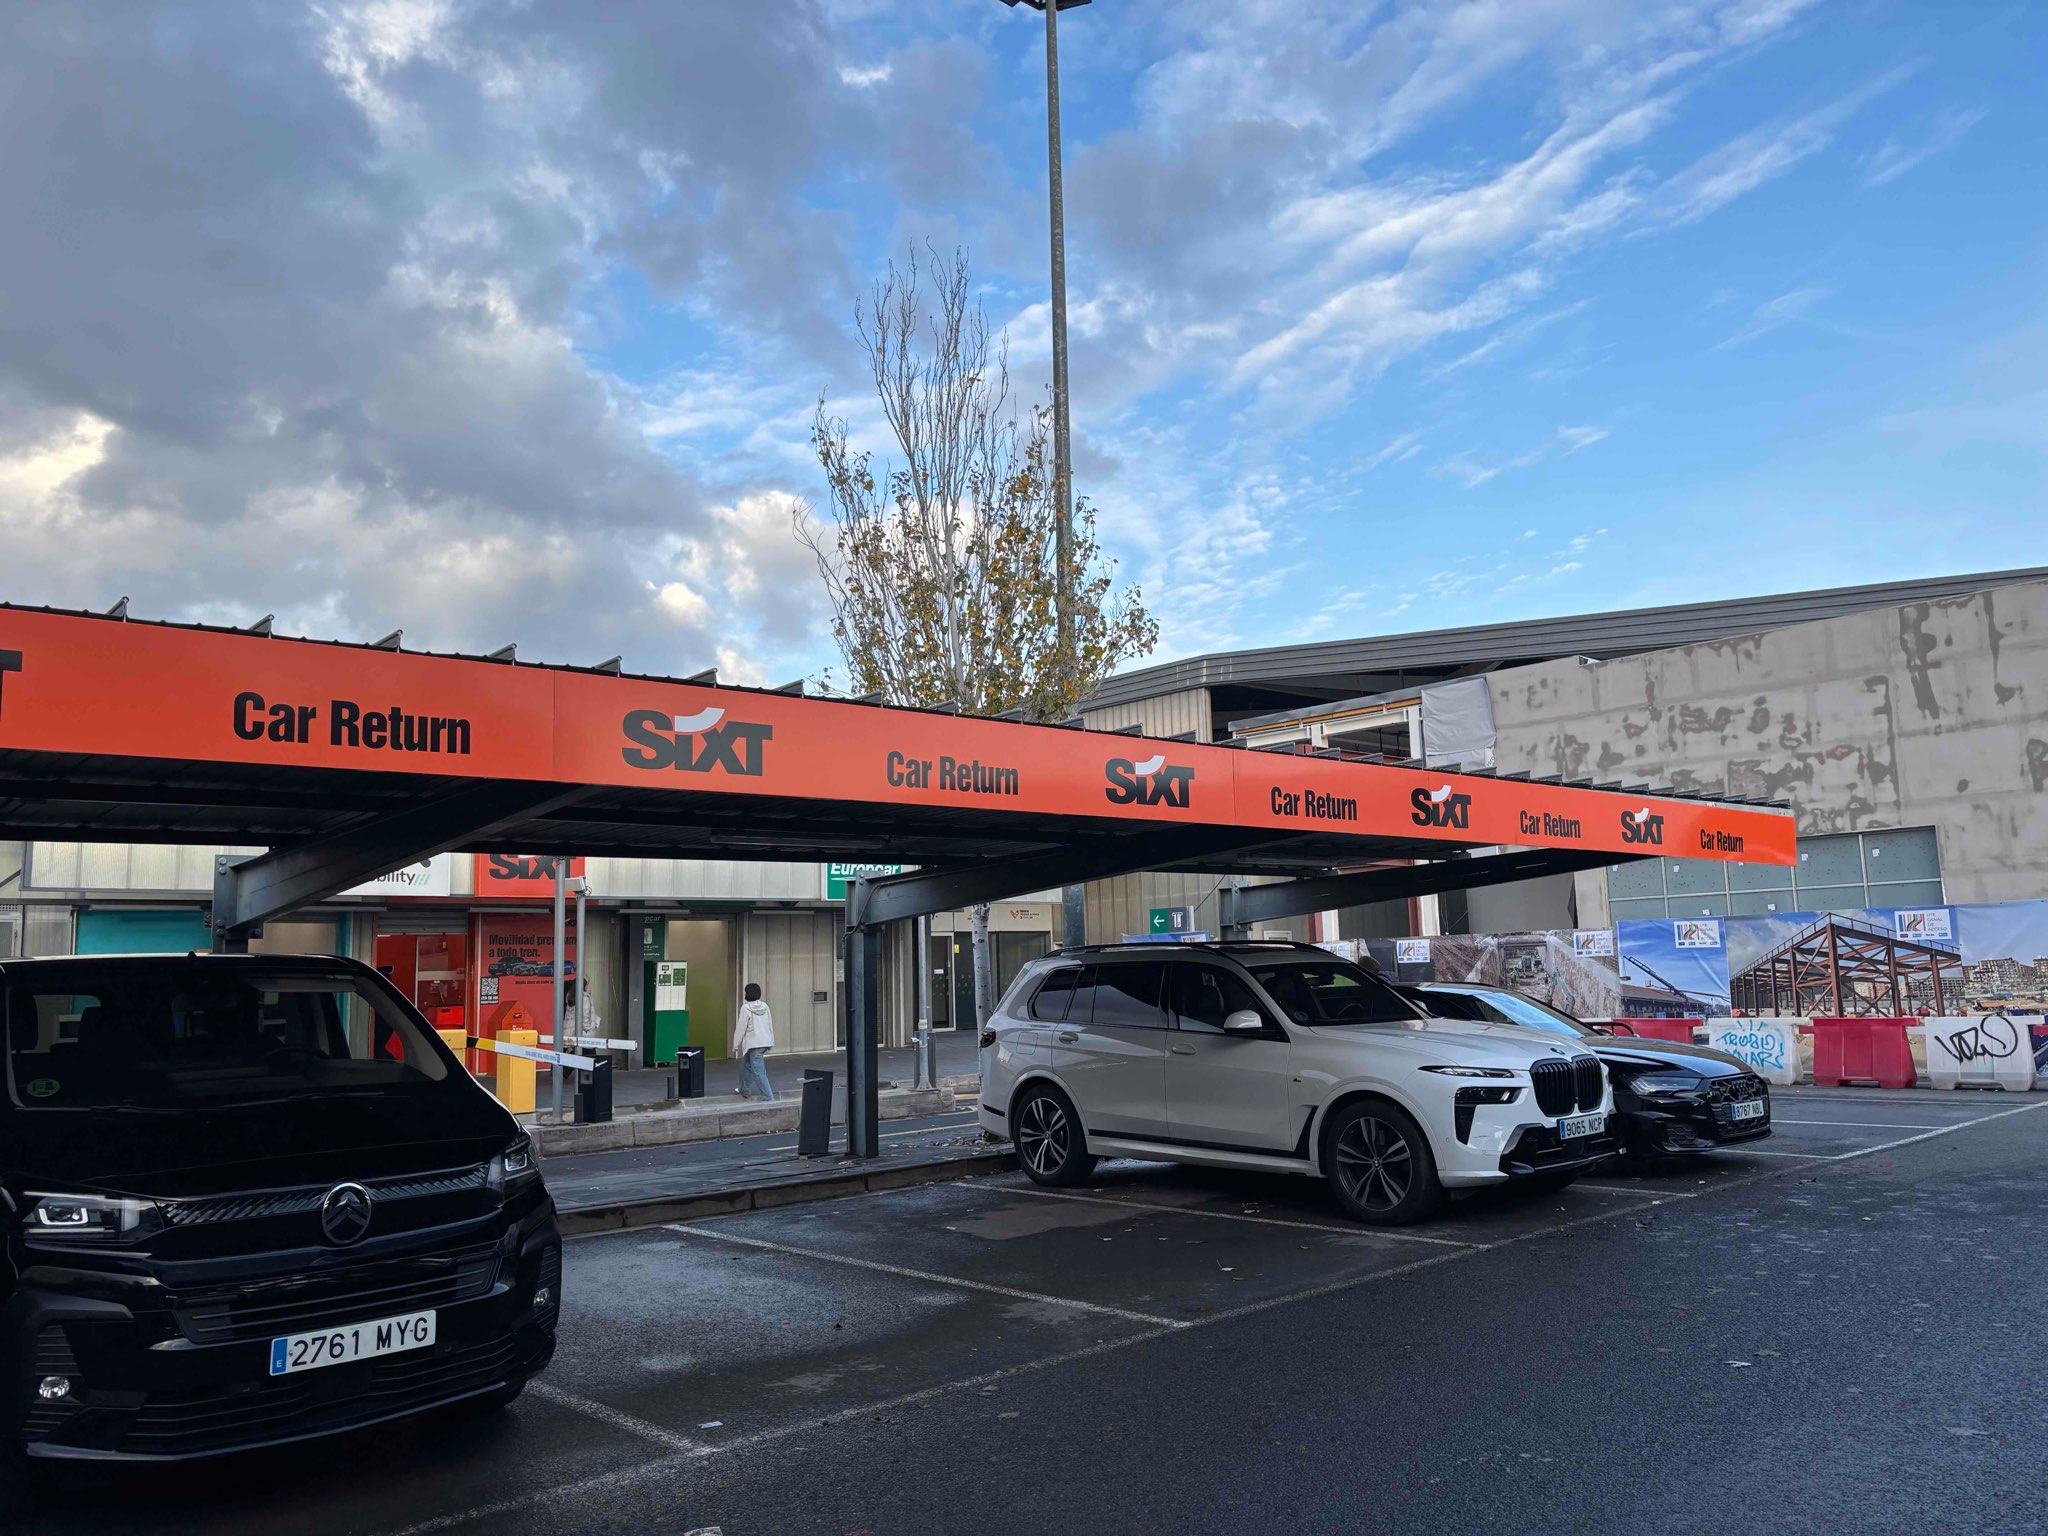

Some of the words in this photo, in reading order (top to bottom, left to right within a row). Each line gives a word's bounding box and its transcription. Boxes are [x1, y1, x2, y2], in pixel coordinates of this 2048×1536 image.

[233, 691, 317, 744] Car
[330, 699, 471, 755] Return
[887, 751, 932, 789] Car
[939, 756, 1019, 796] Return
[1270, 786, 1301, 817] Car
[1304, 789, 1358, 821] Return
[1519, 809, 1541, 835] Car
[1543, 812, 1581, 839] Return
[1700, 828, 1715, 850] Car
[1716, 830, 1744, 853] Return
[488, 934, 535, 946] Movilidad
[537, 936, 578, 946] preum
[488, 949, 495, 958] a
[497, 946, 518, 958] todo
[520, 947, 541, 958] tren.
[1736, 1103, 1751, 1118] 8767
[1566, 1120, 1587, 1137] 9065
[1589, 1117, 1603, 1133] NCP
[291, 1329, 360, 1368] 2761
[376, 1316, 428, 1351] MYG
[276, 1359, 282, 1368] E
